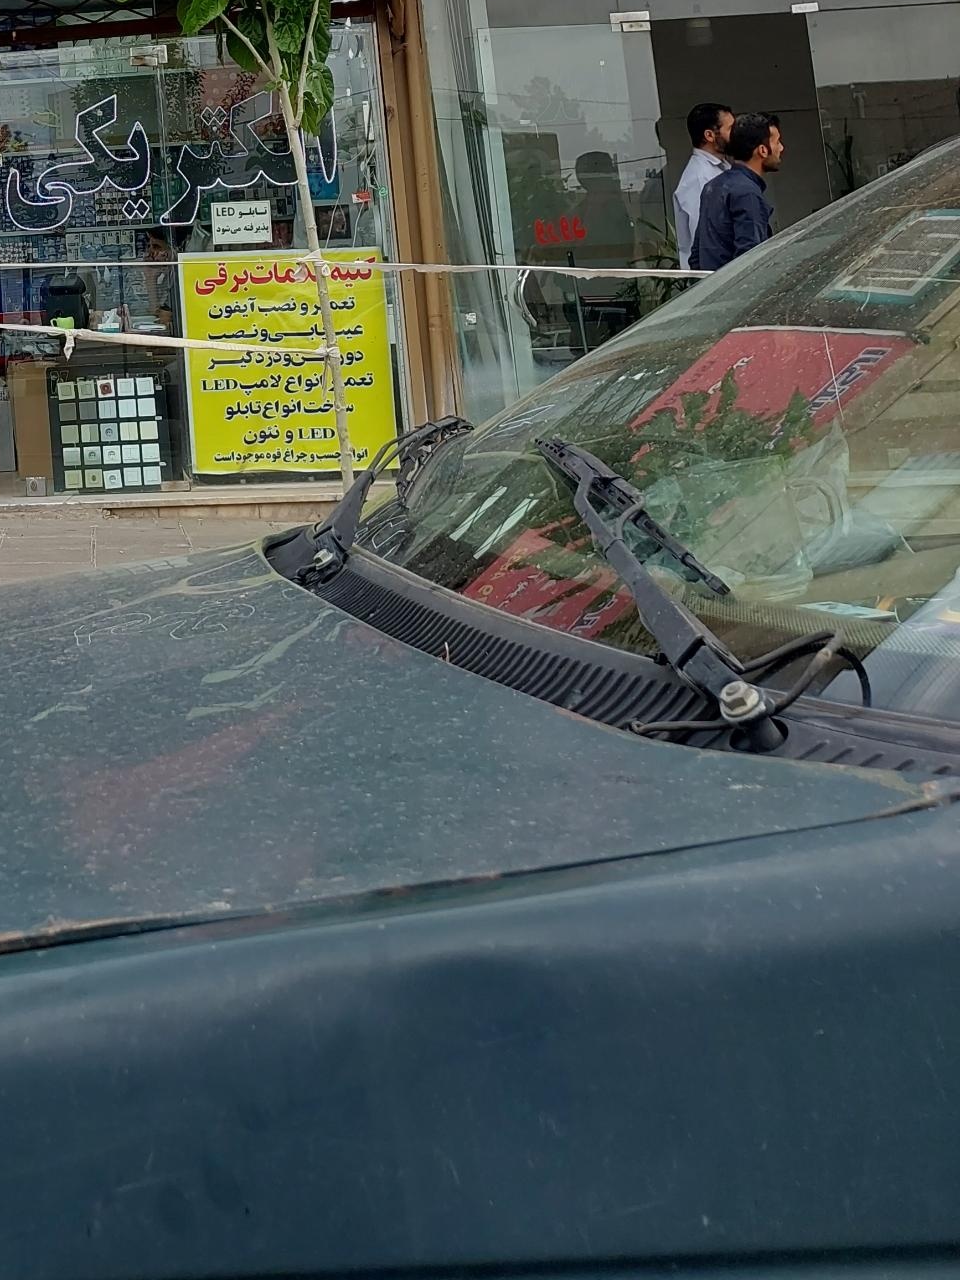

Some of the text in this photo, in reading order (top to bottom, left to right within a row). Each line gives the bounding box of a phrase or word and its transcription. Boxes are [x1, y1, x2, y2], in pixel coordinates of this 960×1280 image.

[216, 206, 268, 219] تابلو LED
[250, 261, 322, 284] دمات
[208, 297, 257, 320] آیفون
[257, 297, 297, 318] نصب
[311, 296, 356, 317] تعمر
[291, 350, 364, 368] دورن
[201, 379, 239, 391] LED
[240, 374, 282, 396] لامپ
[328, 372, 373, 392] تعمر
[224, 398, 355, 421] سخت انواع تابلو
[243, 425, 336, 446] LED و نئون
[214, 450, 236, 462] است
